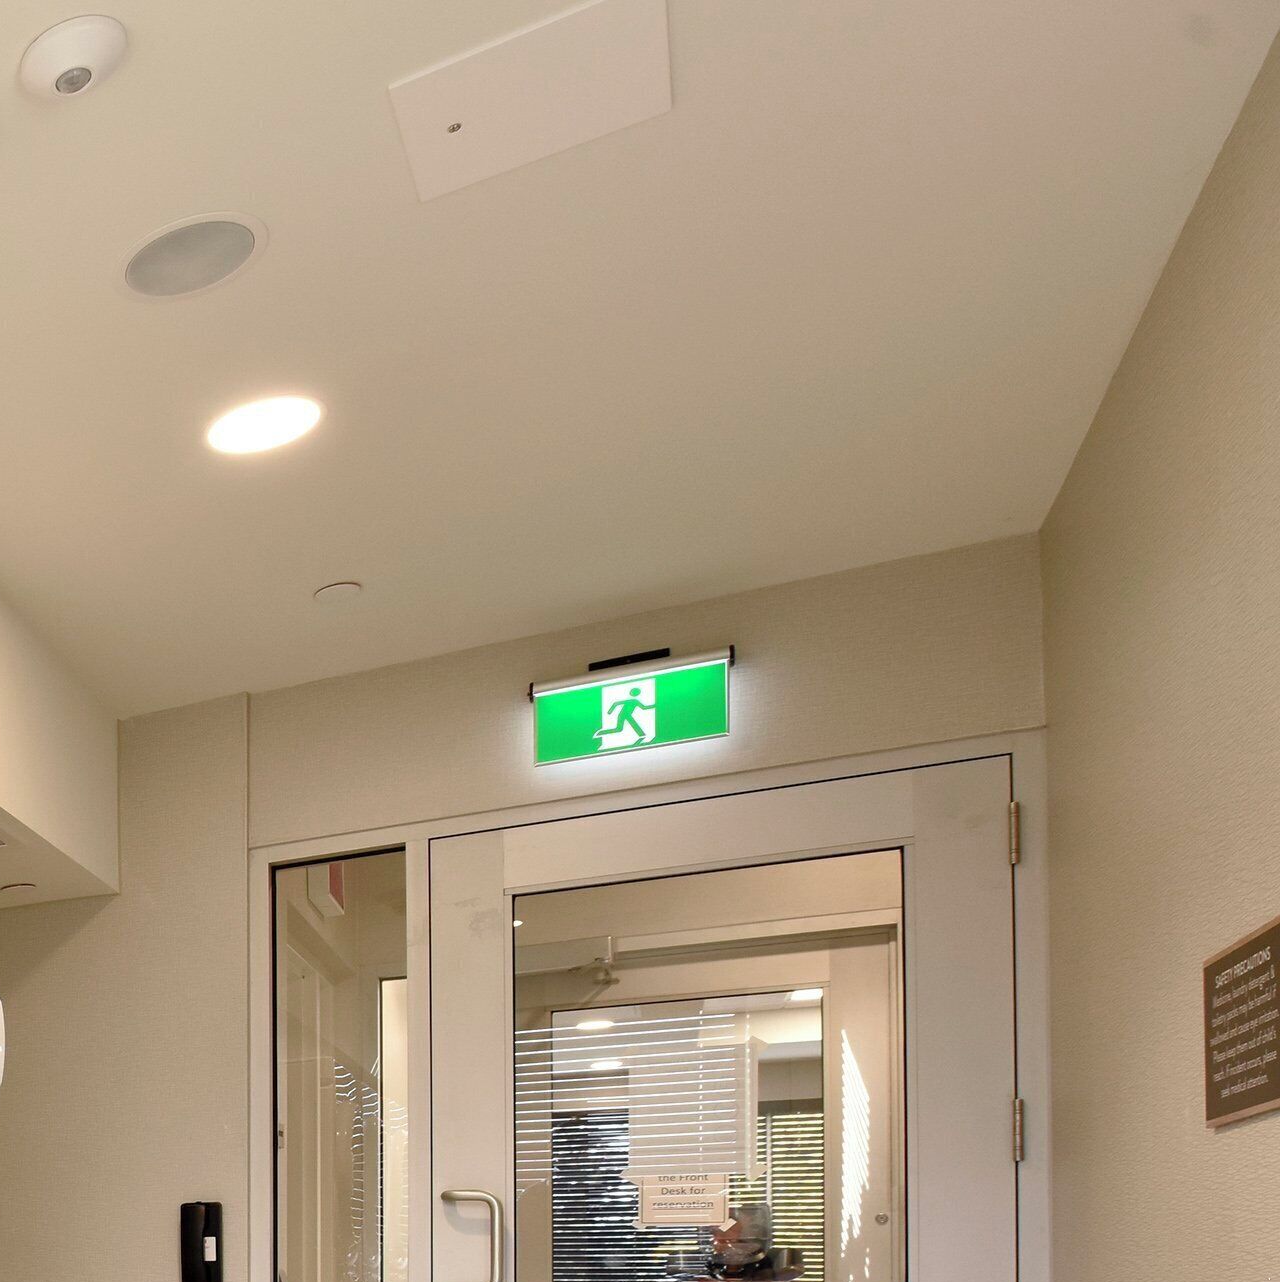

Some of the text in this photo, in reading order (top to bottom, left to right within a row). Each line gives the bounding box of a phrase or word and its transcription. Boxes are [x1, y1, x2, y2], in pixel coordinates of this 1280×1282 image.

[1215, 946, 1271, 989] SAFETY PRECAUTIONS
[661, 1186, 706, 1195] Desk for
[652, 1201, 715, 1209] reservation
